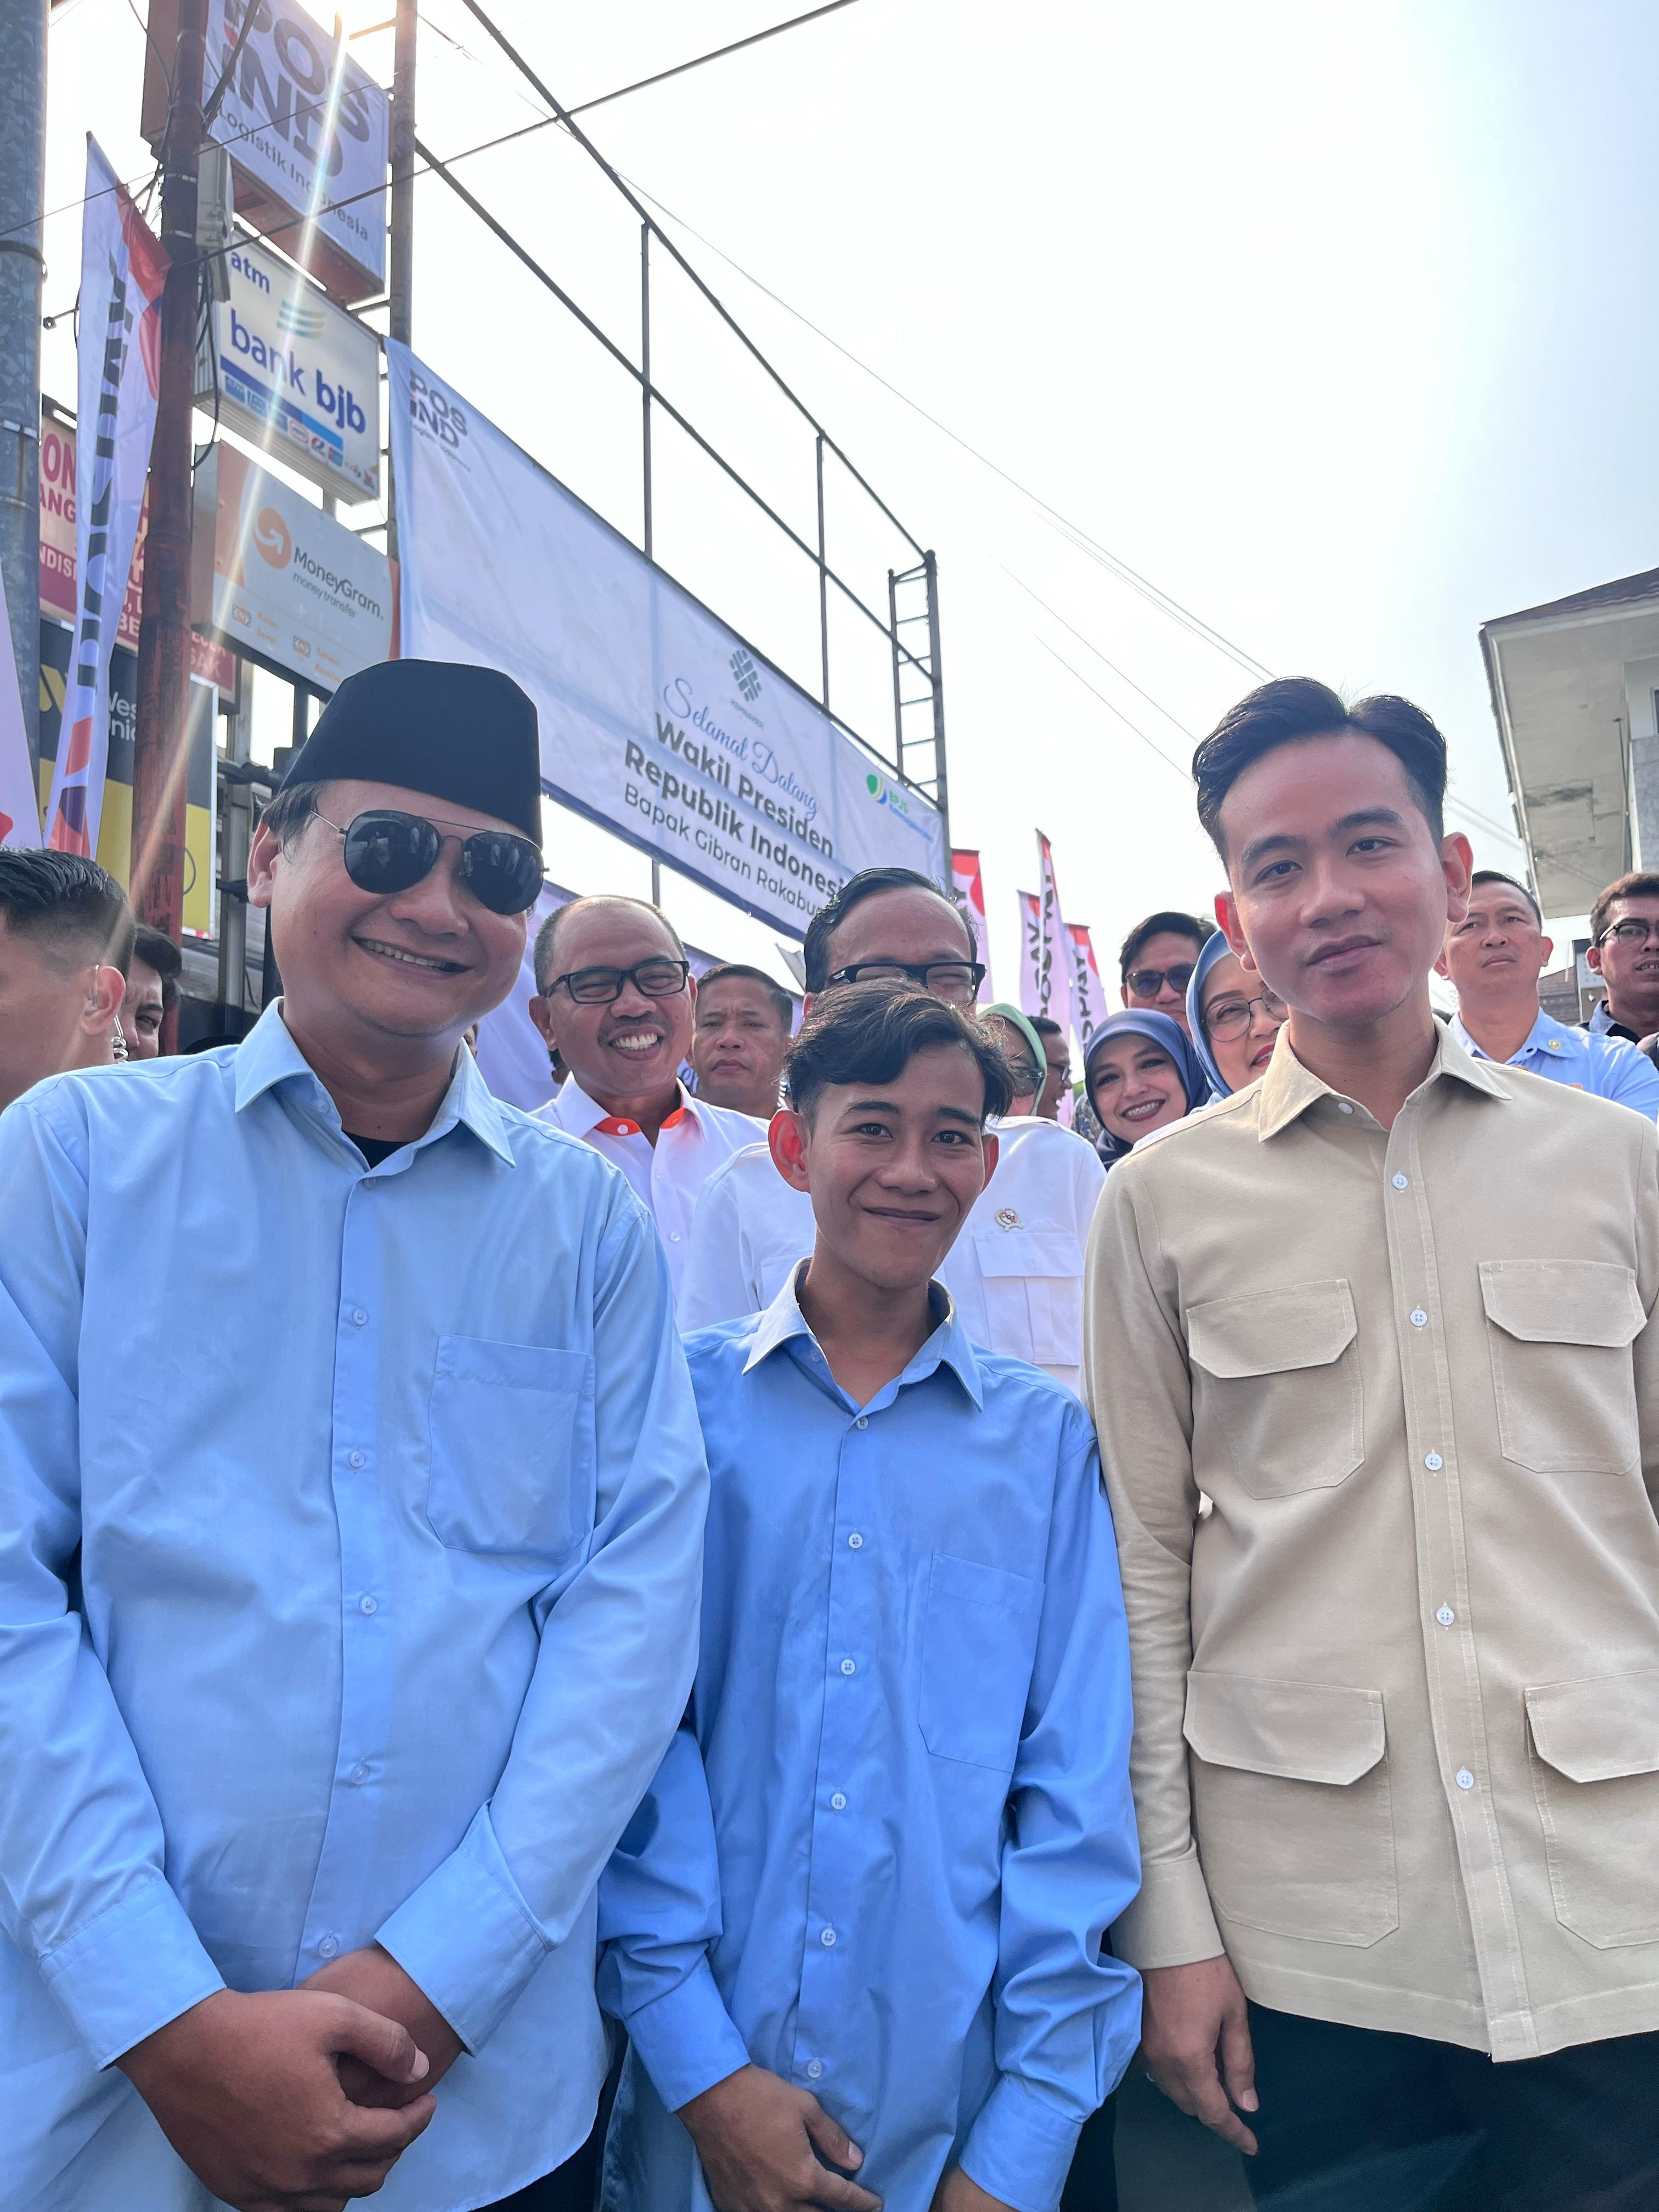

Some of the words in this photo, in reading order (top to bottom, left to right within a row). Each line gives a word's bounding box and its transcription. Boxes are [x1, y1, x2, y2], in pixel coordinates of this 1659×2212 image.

[231, 251, 270, 294] atm
[231, 309, 306, 397] bank
[316, 368, 366, 435] bjb
[410, 369, 468, 437] POS
[292, 572, 323, 600] money
[323, 592, 357, 618] transfer
[625, 739, 744, 843] Republik
[655, 712, 731, 789] Wakil
[738, 774, 833, 859] Presiden
[663, 678, 748, 761] Selamat
[751, 741, 820, 821] Datang
[625, 783, 690, 842] Bapak
[695, 829, 751, 879] Gibran
[757, 867, 817, 916] Rakabu
